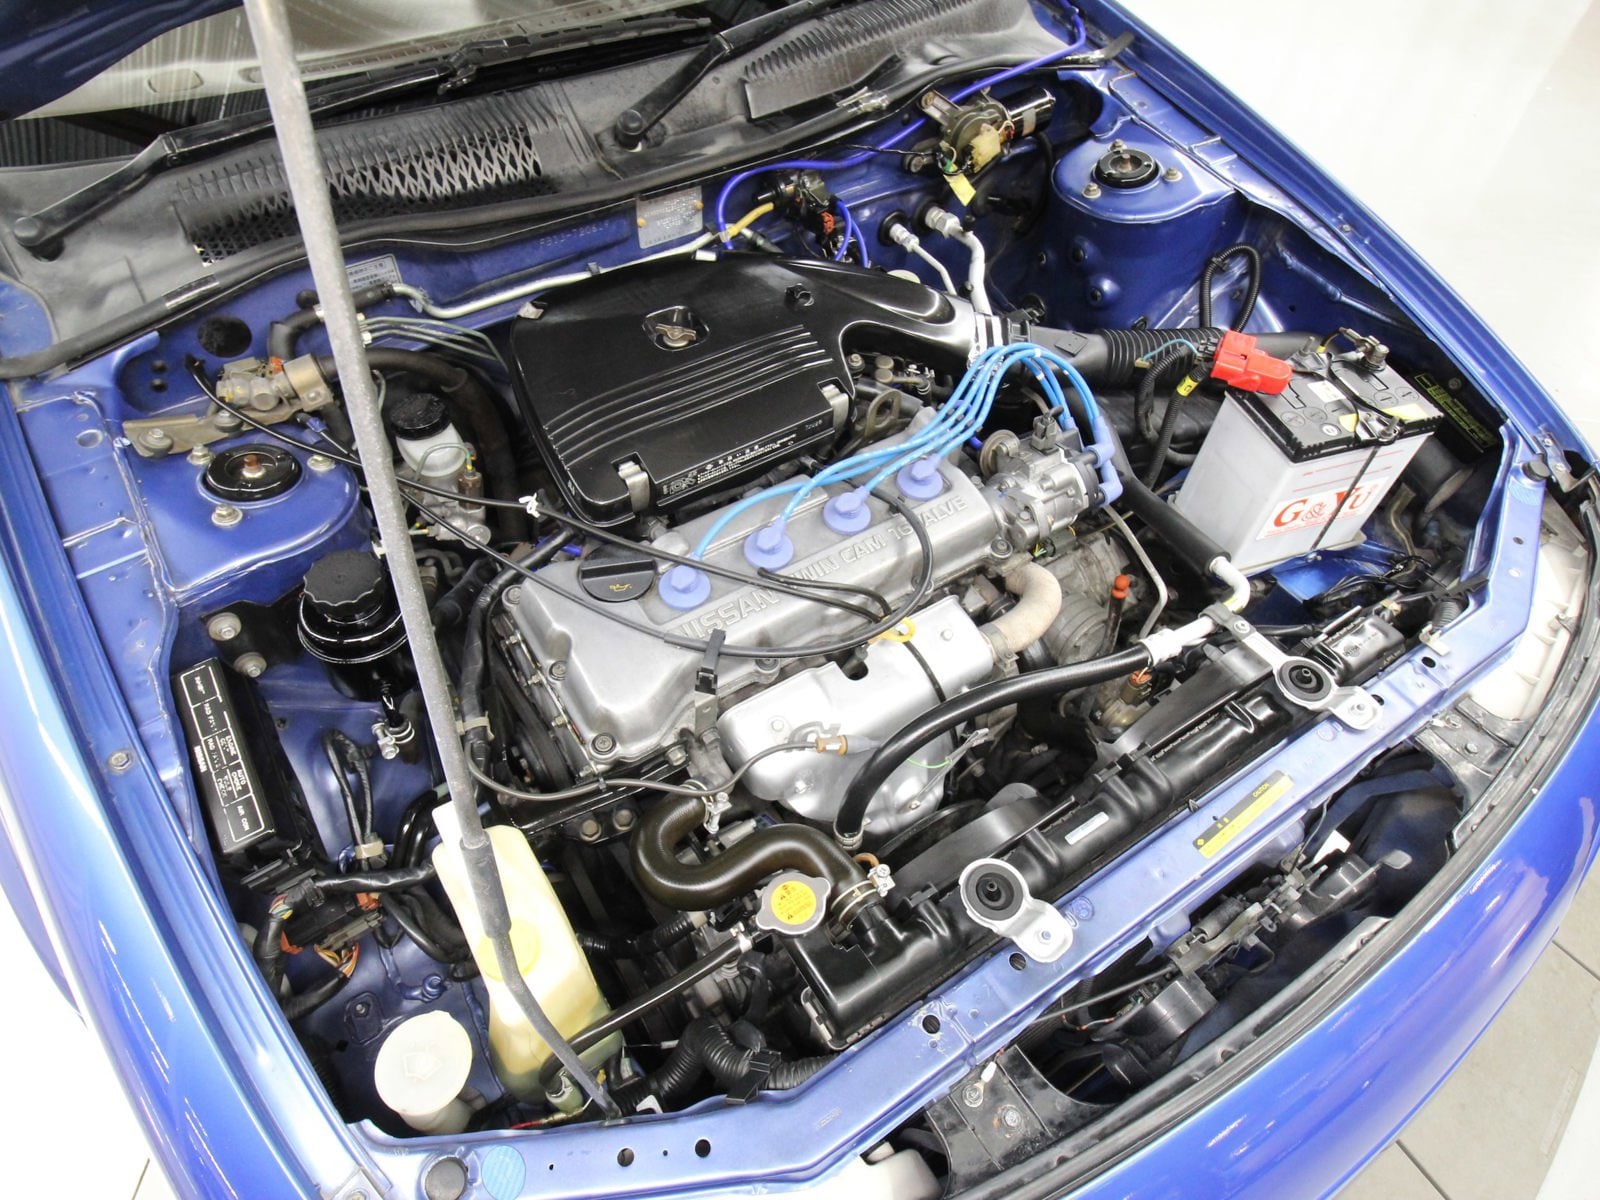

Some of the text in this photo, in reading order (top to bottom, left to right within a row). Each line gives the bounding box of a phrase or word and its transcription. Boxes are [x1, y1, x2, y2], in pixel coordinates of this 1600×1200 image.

[838, 534, 887, 564] CAM
[887, 522, 914, 541] 16
[236, 805, 246, 817] AIR
